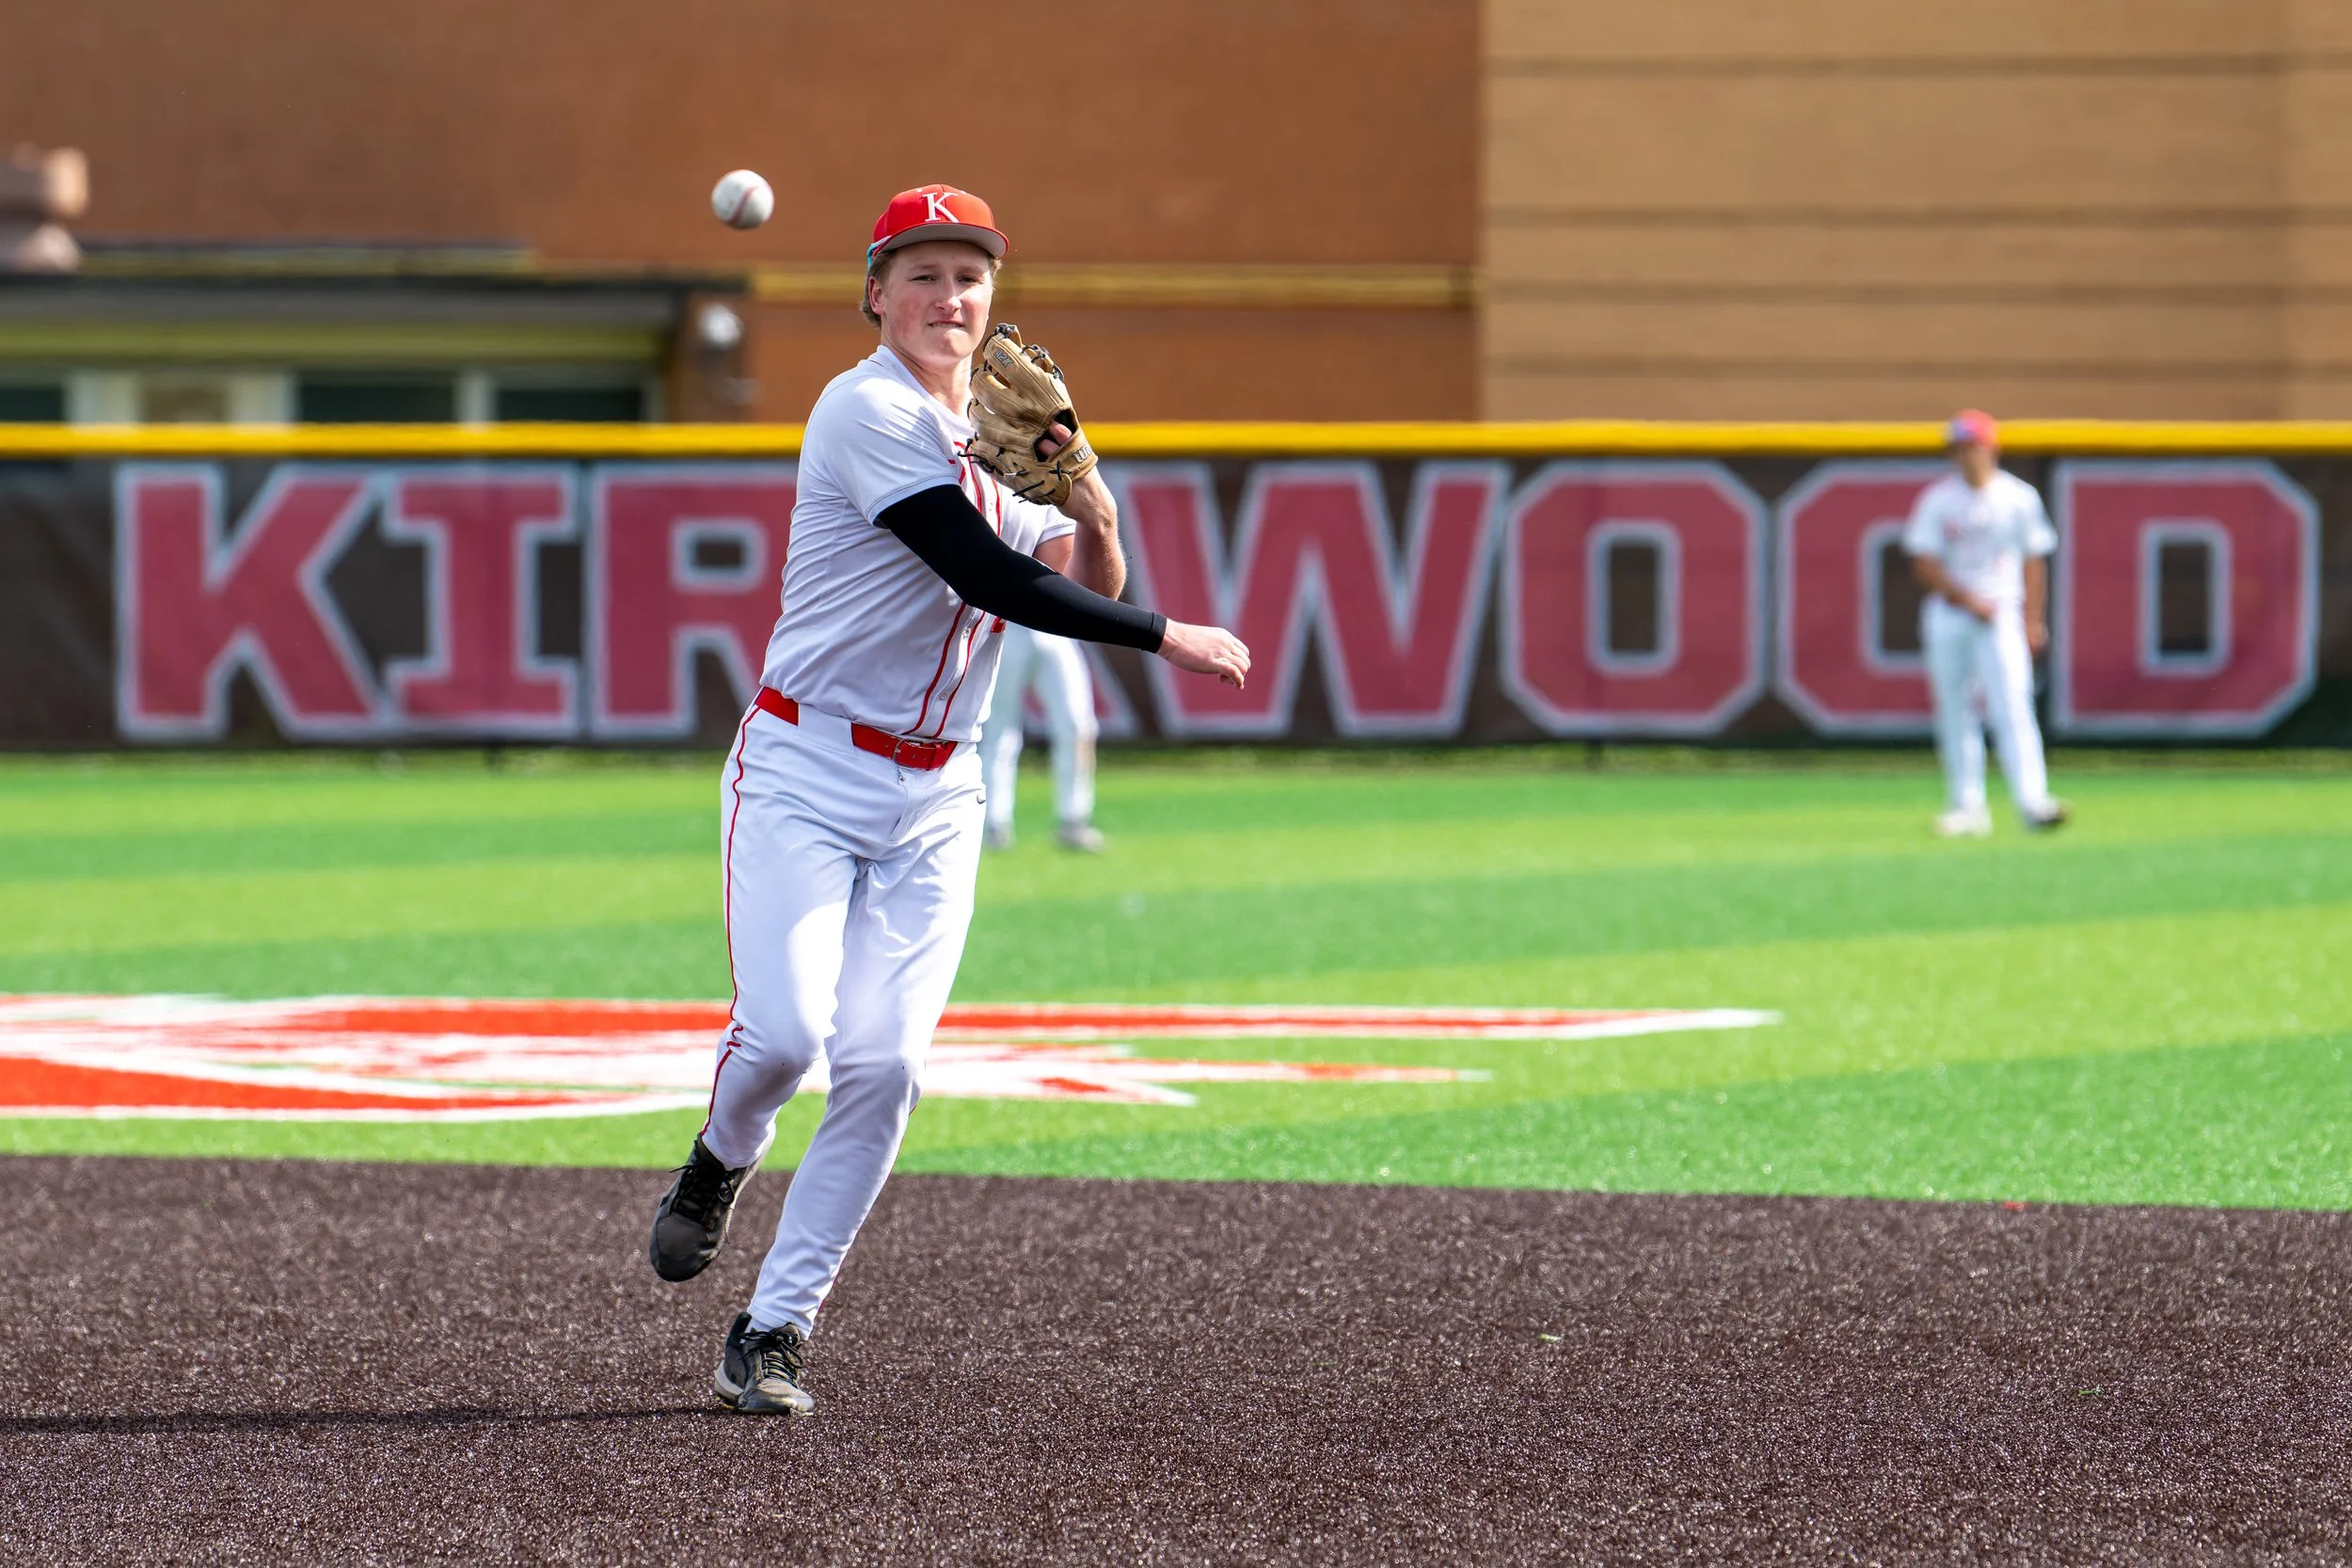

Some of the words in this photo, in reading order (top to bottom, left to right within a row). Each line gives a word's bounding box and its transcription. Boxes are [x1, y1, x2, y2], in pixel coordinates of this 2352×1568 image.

[922, 192, 960, 223] K
[993, 349, 1014, 368] A2K
[115, 461, 2318, 740] KIRWOOD
